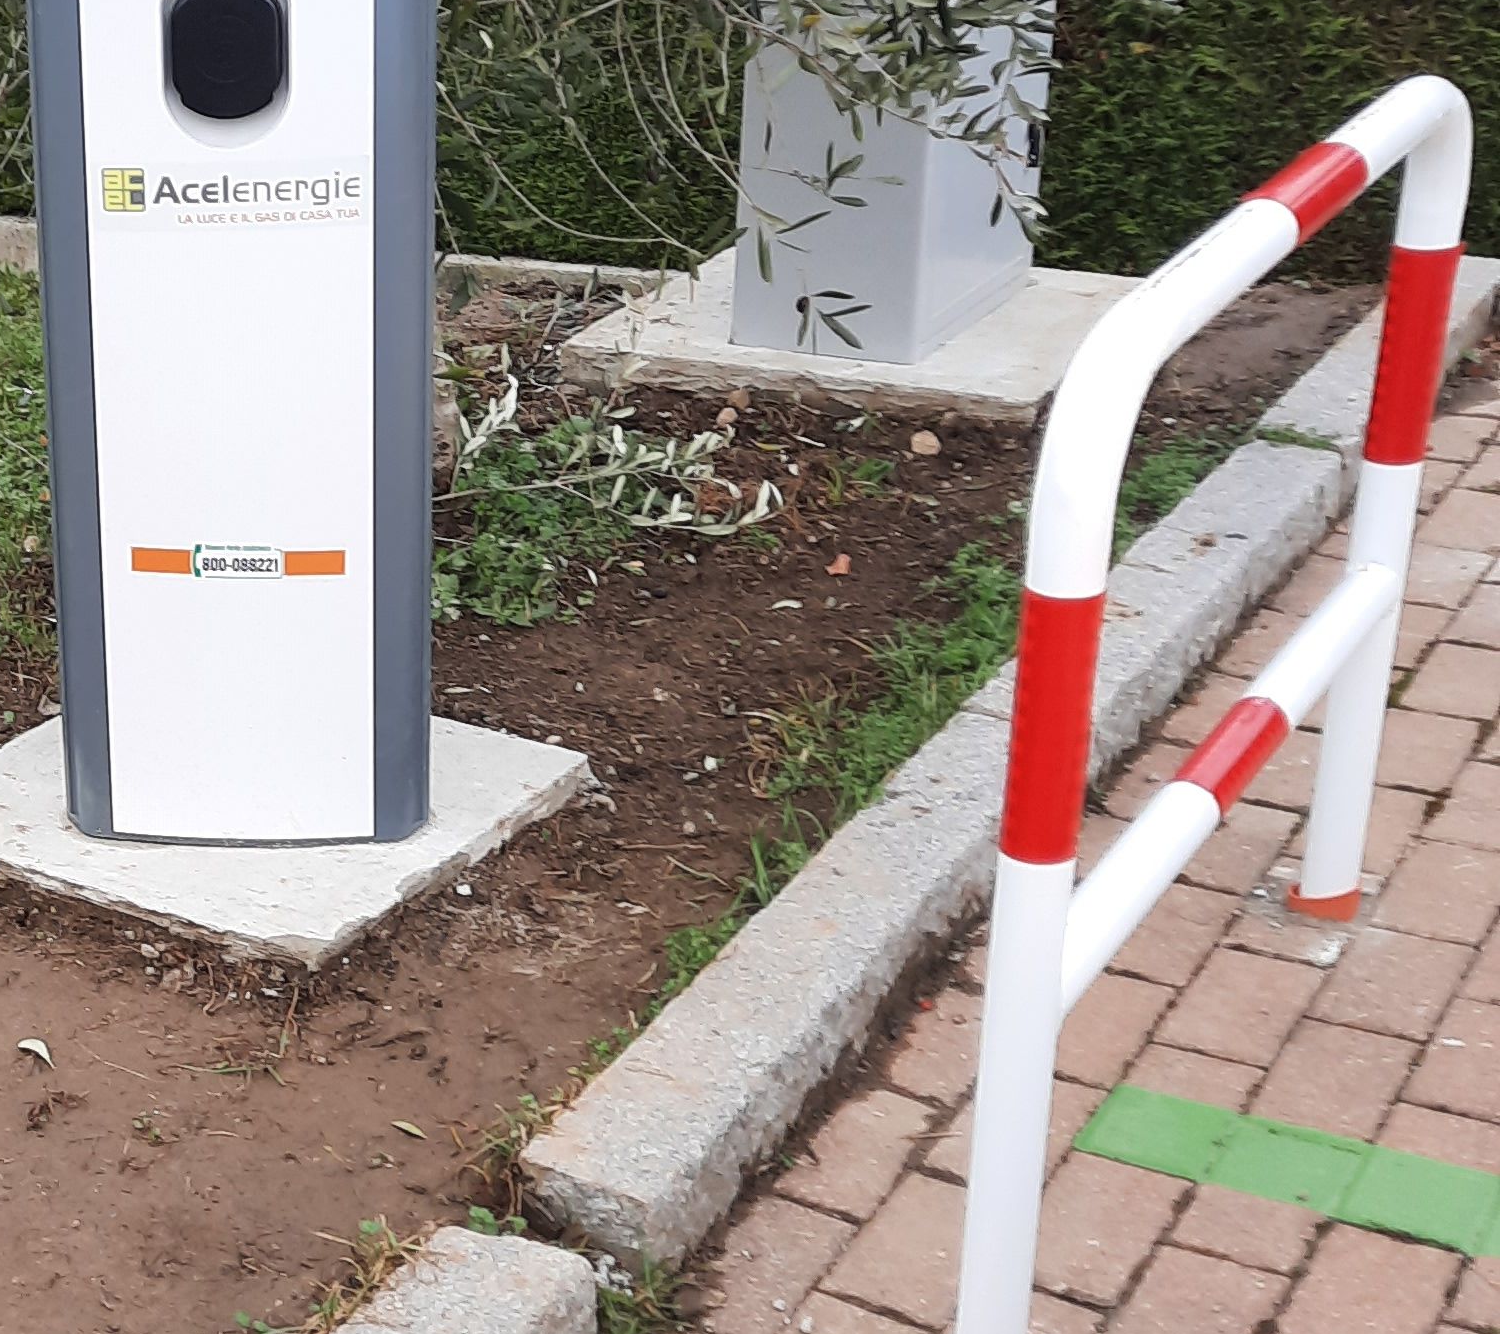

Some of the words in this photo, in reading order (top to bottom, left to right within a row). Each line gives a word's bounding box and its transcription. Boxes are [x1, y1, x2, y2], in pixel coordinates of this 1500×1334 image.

[152, 171, 361, 206] Acelenergie
[177, 214, 194, 224] LA
[196, 213, 227, 224] LUCE
[229, 213, 238, 224] E
[299, 209, 333, 221] CASA
